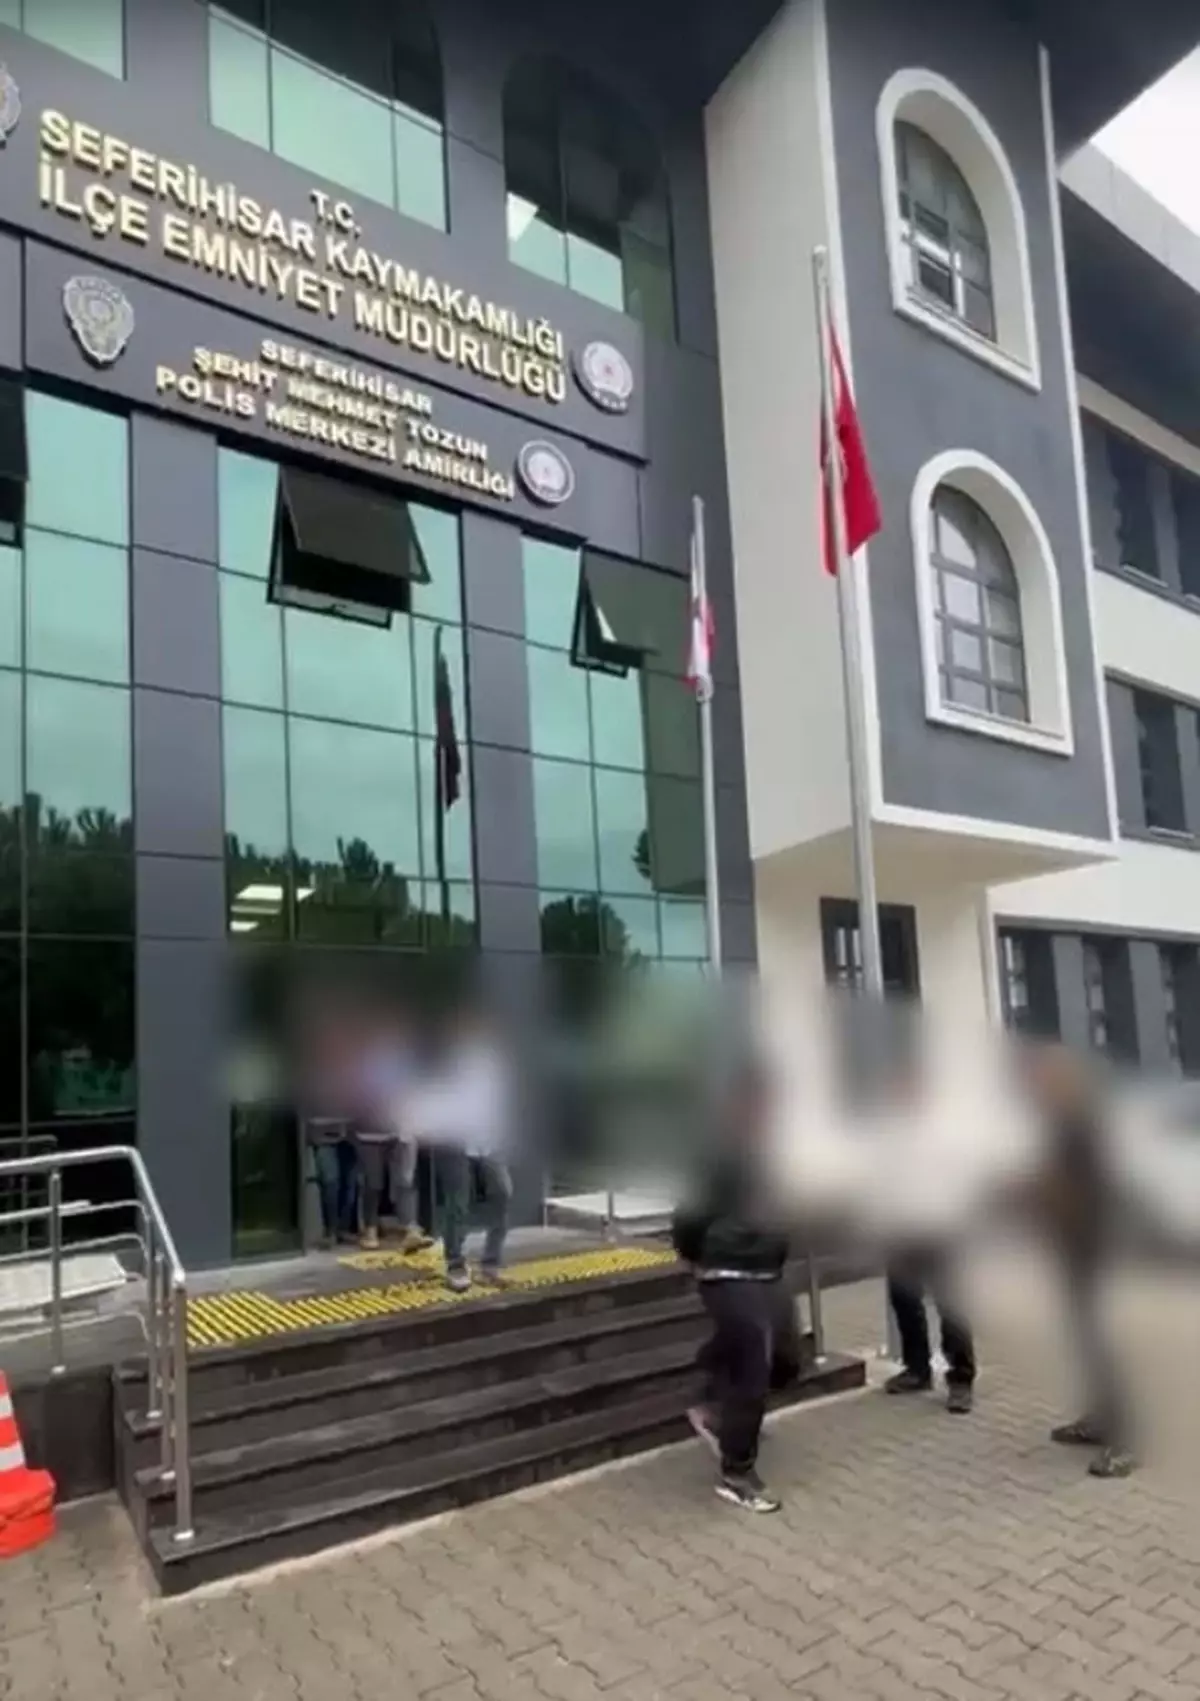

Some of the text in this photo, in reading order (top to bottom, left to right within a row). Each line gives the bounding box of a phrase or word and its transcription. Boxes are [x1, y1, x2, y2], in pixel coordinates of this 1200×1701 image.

[39, 108, 565, 360] SEFERİHİSAR KAYMAKAMLIĞI
[310, 188, 361, 237] T.C.
[39, 151, 567, 403] İLÇE EMNİYET MÜDÜRLÜĞÜ
[265, 403, 397, 461] MERKEZİ
[287, 378, 398, 430] MEHMET
